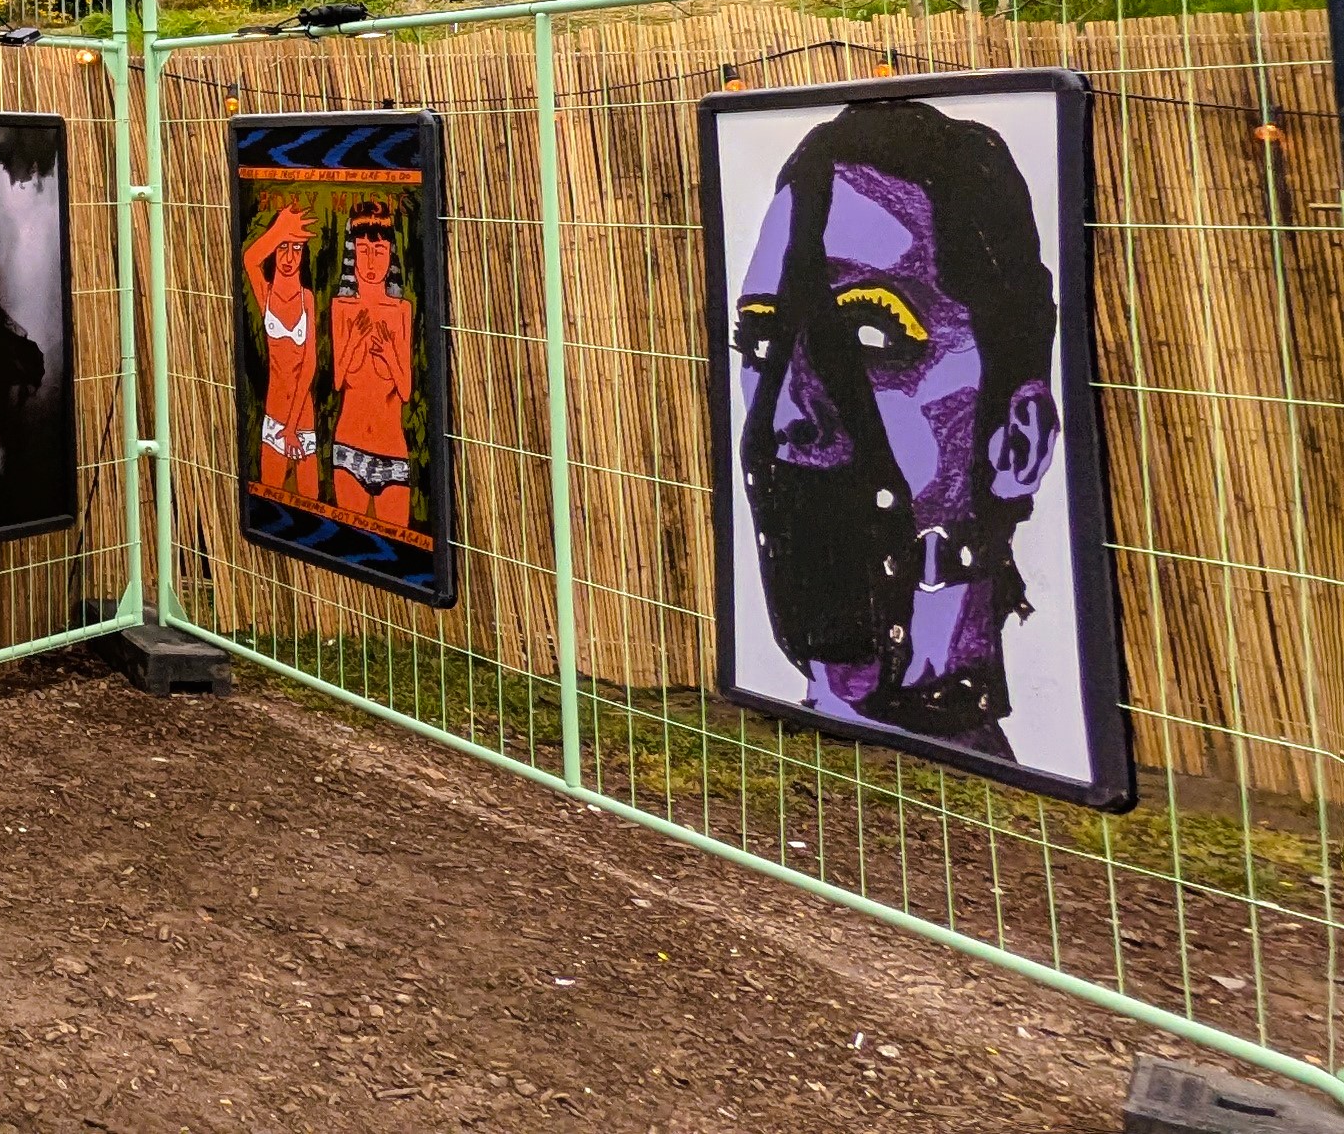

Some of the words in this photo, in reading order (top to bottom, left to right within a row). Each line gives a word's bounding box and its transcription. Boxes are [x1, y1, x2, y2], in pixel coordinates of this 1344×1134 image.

[259, 189, 318, 213] ROXY
[331, 191, 409, 216] MUSIC
[331, 509, 350, 522] GOT
[399, 529, 430, 546] AGAIN
